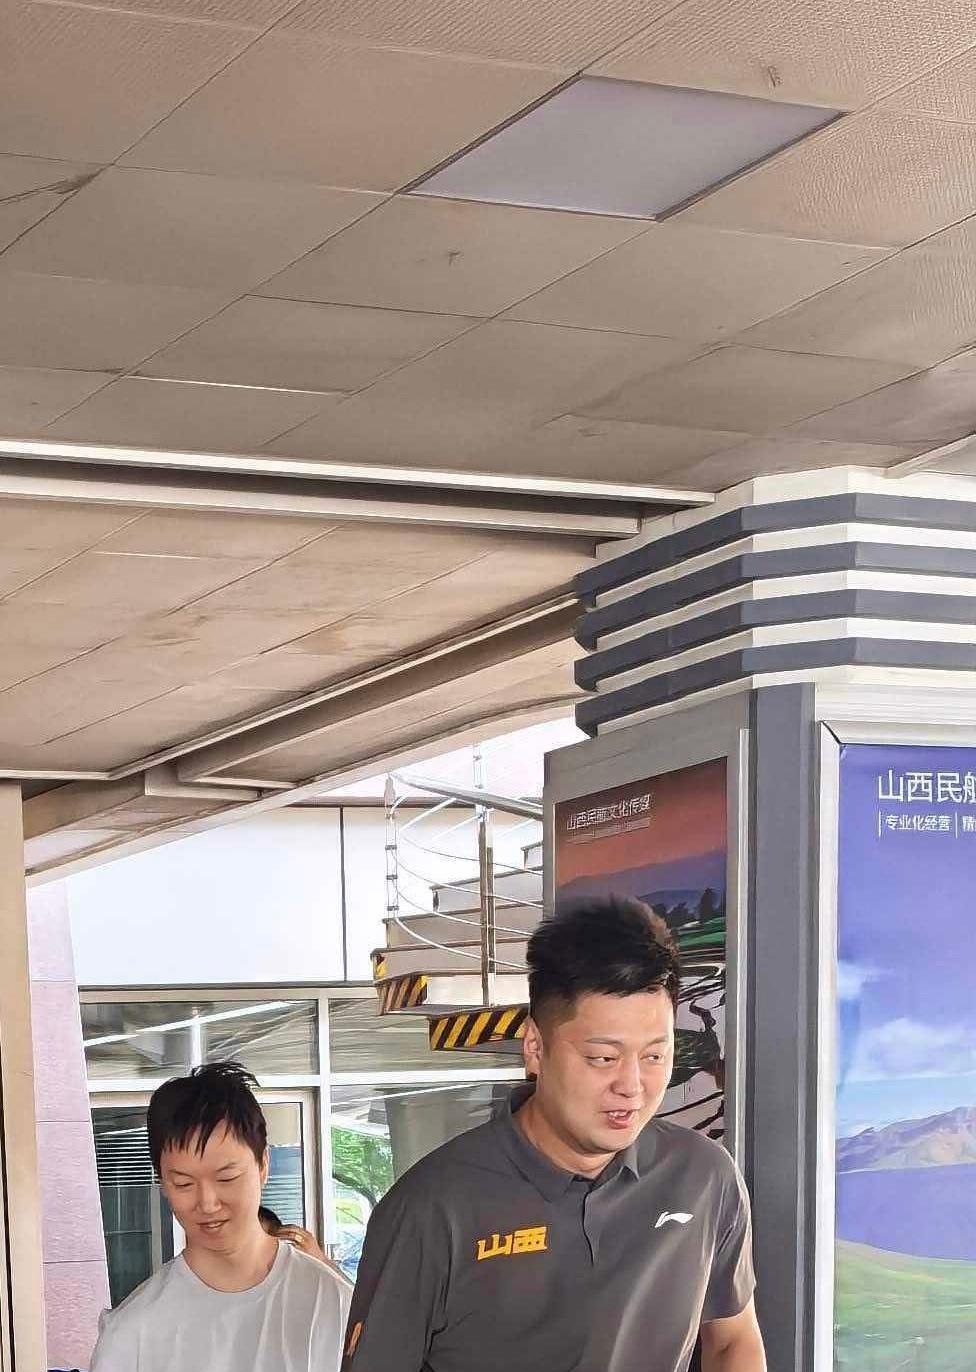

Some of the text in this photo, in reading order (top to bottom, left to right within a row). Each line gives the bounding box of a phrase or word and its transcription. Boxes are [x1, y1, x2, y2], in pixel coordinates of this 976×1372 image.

[886, 814, 952, 832] 专业化经营
[477, 1226, 548, 1261] 山西
